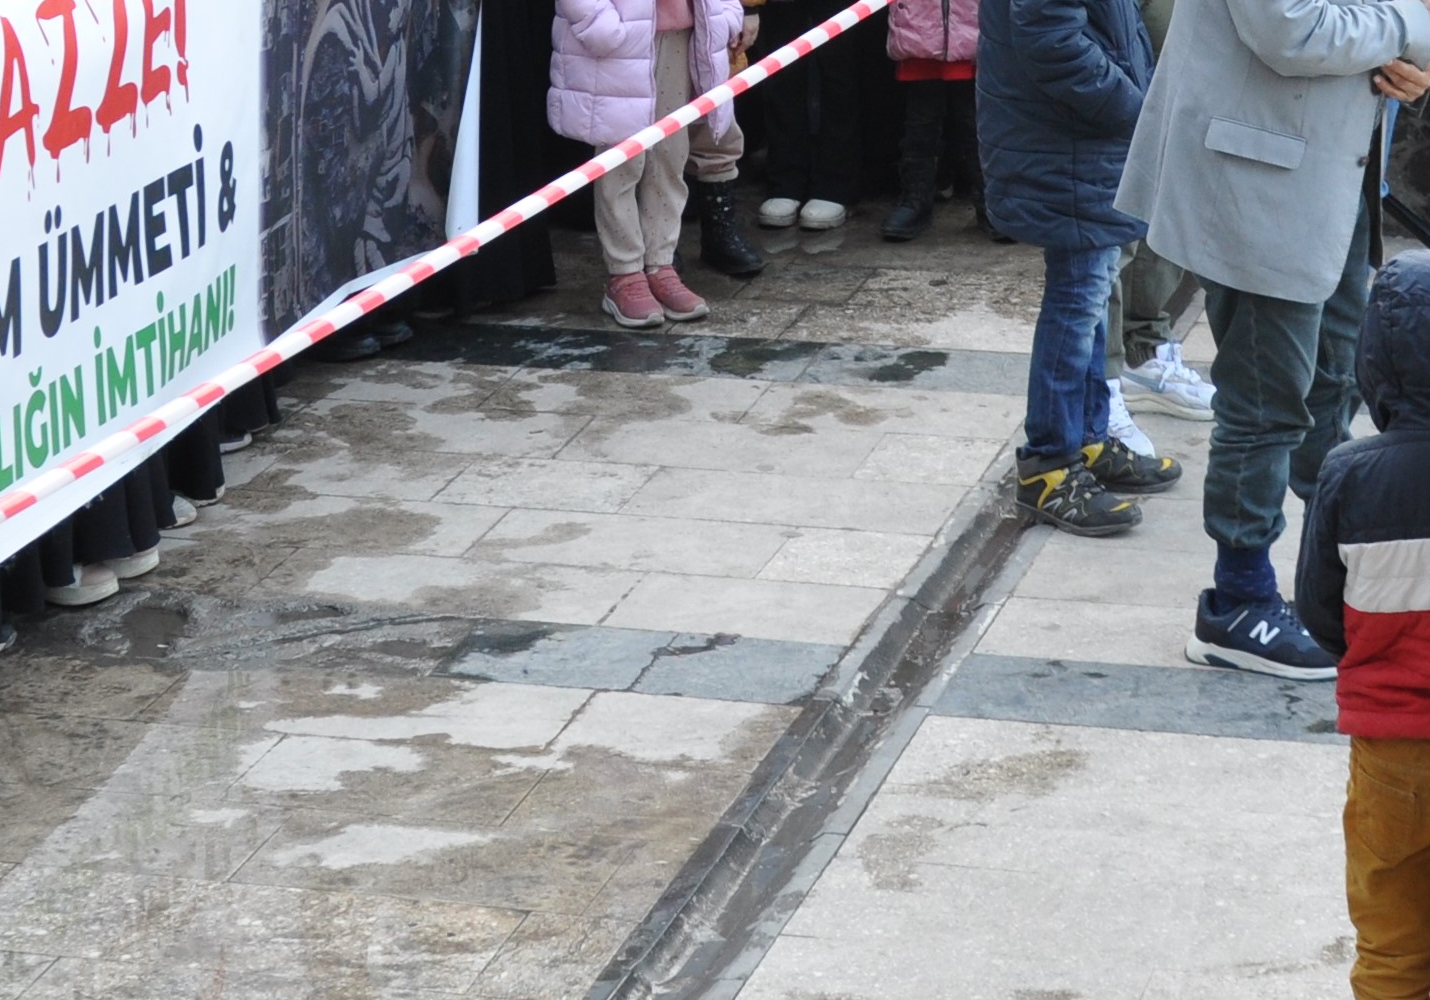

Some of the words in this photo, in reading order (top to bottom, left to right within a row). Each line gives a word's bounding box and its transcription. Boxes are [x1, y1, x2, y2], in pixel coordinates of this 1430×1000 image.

[38, 123, 207, 338] ÜMMETİ
[217, 140, 237, 233] &
[93, 263, 237, 427] İMTİHANI!
